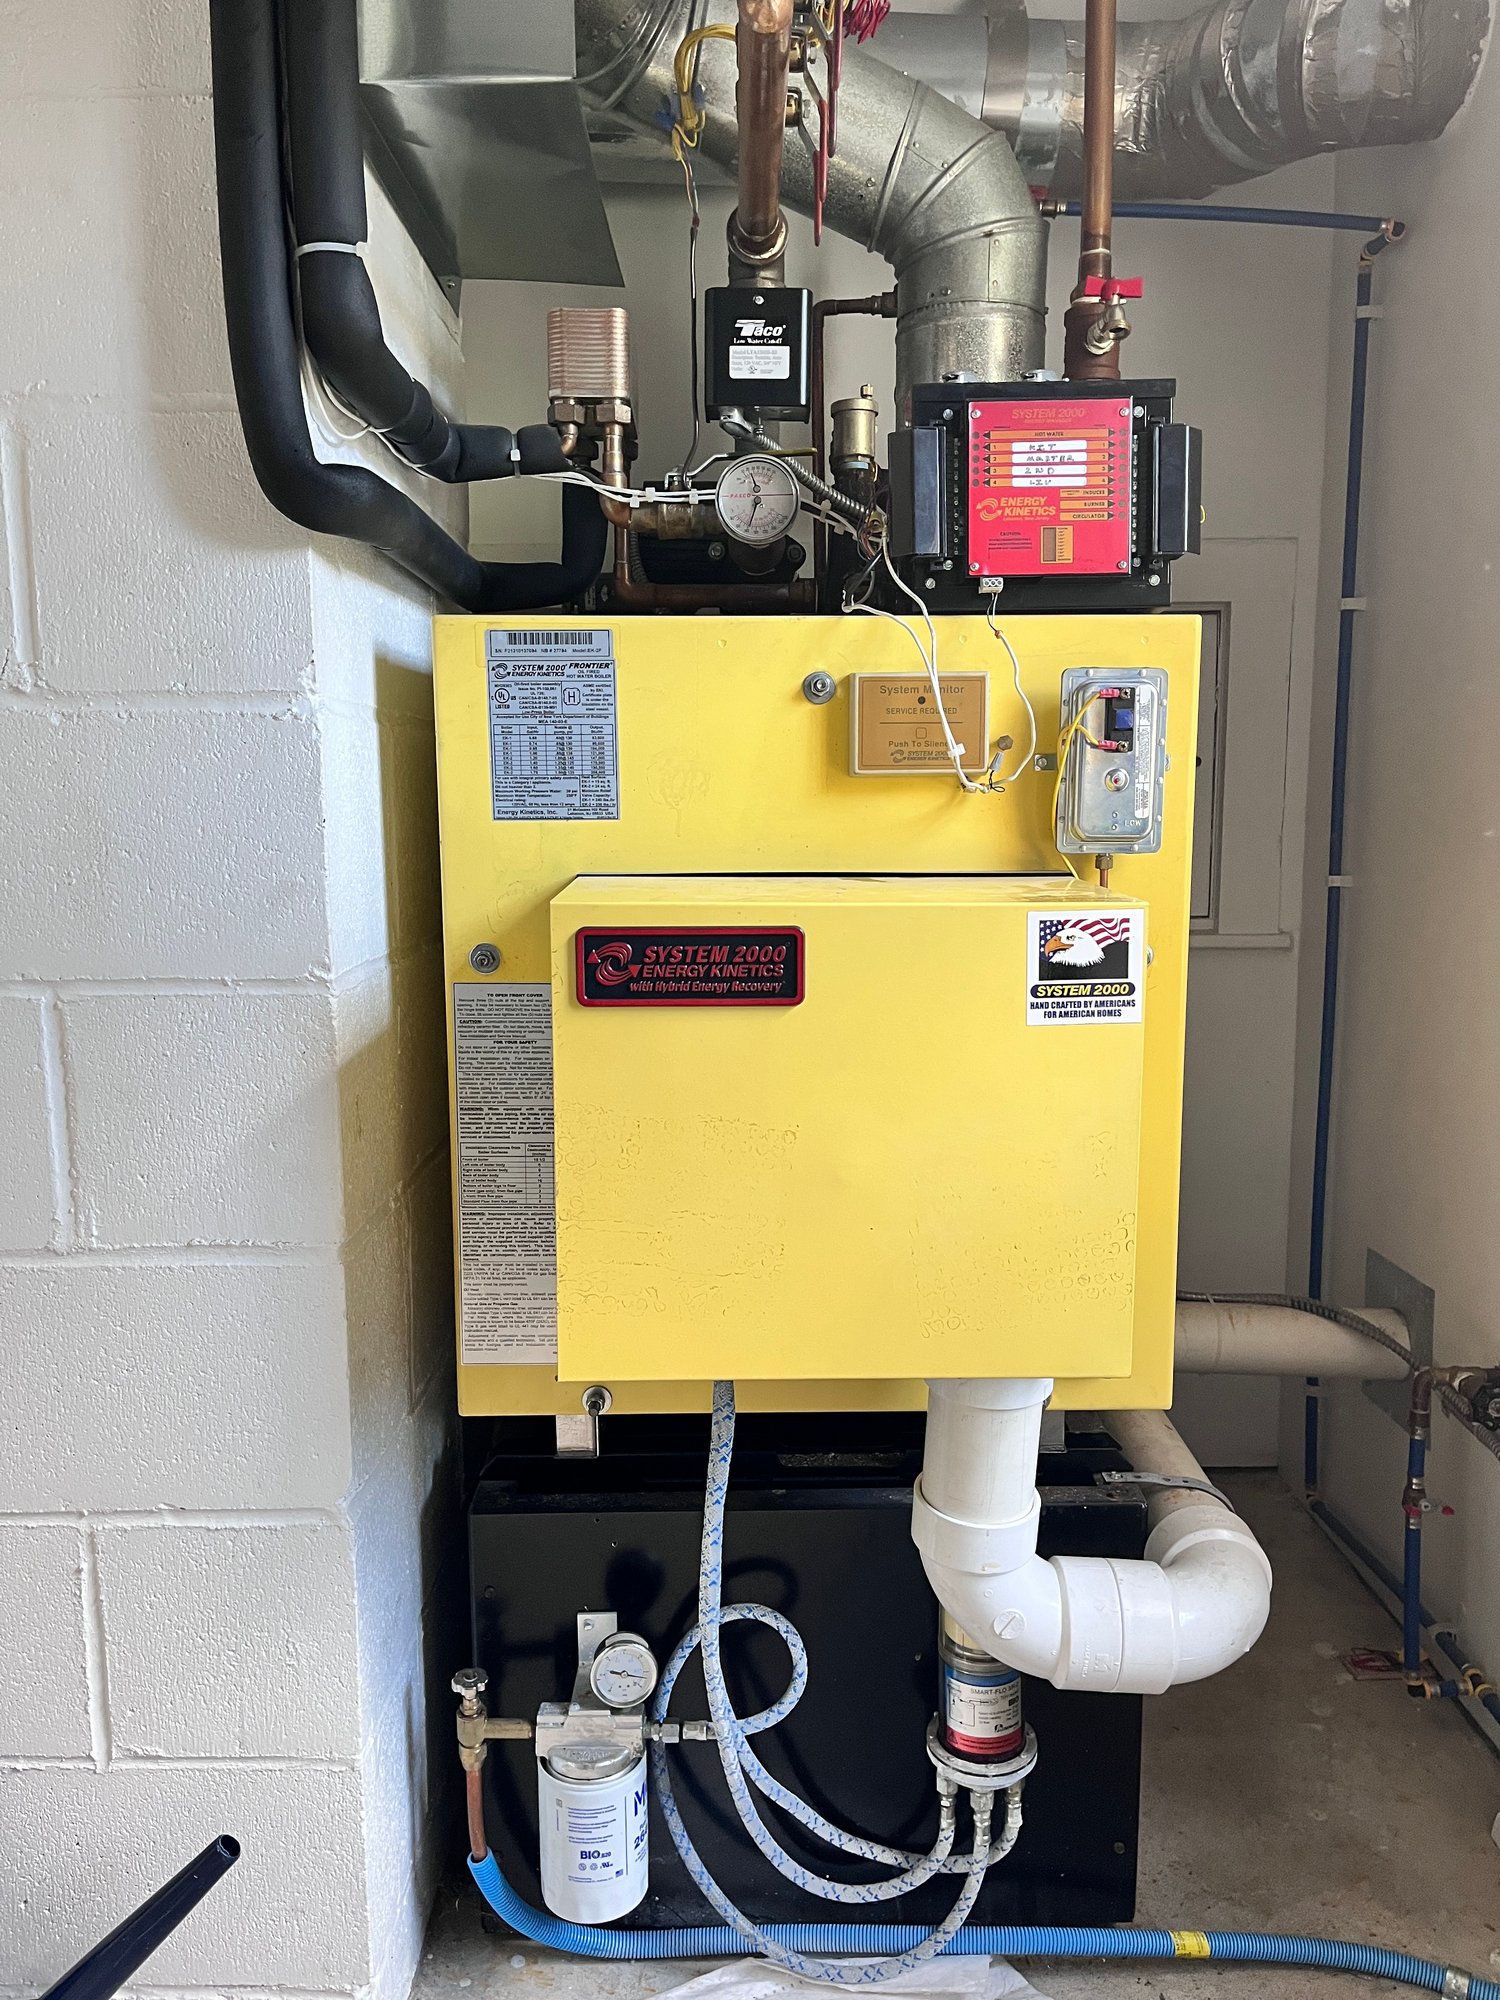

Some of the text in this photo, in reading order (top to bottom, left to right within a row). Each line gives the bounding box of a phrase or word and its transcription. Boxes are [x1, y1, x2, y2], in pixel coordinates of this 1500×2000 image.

[735, 320, 783, 336] Taco
[1012, 408, 1085, 419] SYSTEM 2000
[1000, 497, 1047, 507] ENERGY
[1005, 507, 1056, 516] KINETICS
[880, 686, 965, 696] System Mnitor
[644, 946, 787, 964] SYSTEM 2000
[643, 964, 784, 978] ENERGY KINETICS
[630, 981, 783, 994] with Hybrid Energy Recovery
[1037, 984, 1129, 997] SYSTEM 2000
[1030, 1002, 1050, 1010] HAND
[1051, 1001, 1082, 1009] CRAFTED
[1094, 1000, 1136, 1008] AMERICANS
[1044, 1009, 1122, 1019] FOR AMERICAN HOMES
